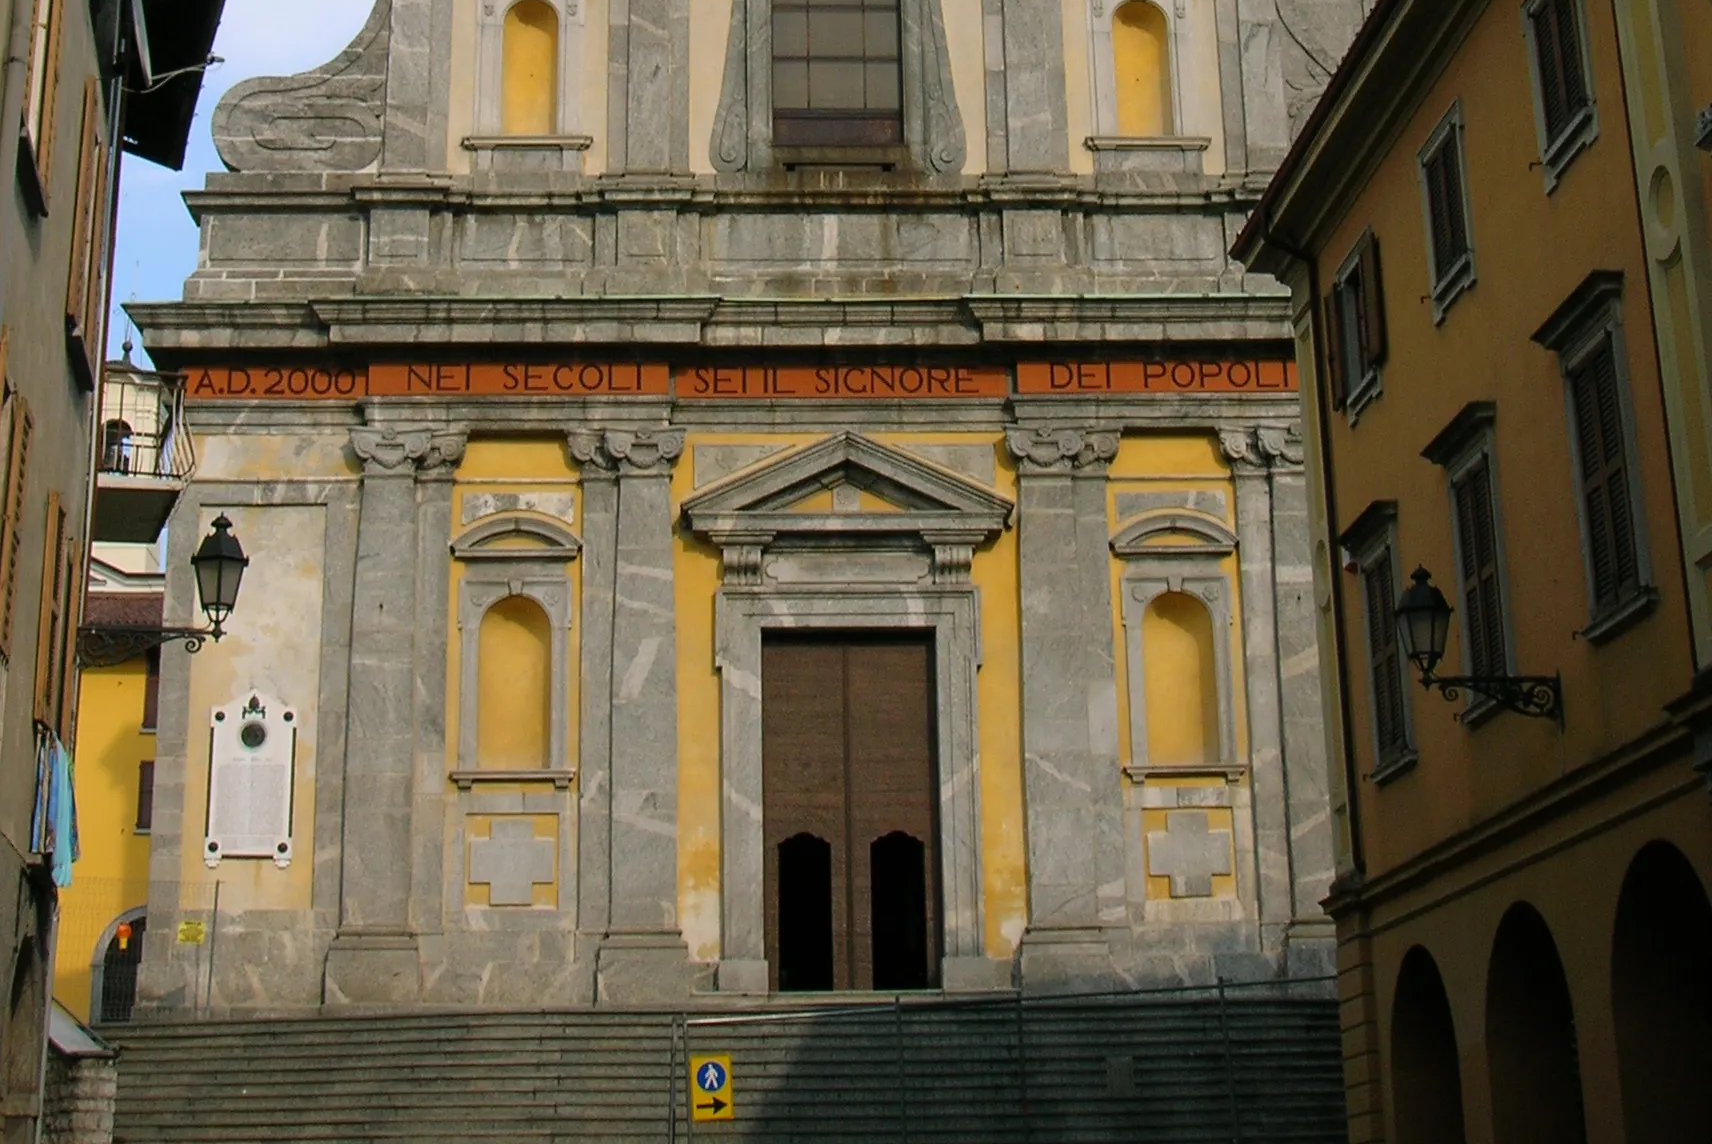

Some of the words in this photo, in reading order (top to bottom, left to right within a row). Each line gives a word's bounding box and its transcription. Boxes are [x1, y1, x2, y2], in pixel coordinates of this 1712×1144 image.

[194, 368, 256, 395] A.D.
[263, 368, 356, 395] 2000
[407, 364, 471, 391] NEI
[502, 364, 642, 391] SECOLI
[694, 367, 748, 394] SEI
[763, 367, 796, 394] IL
[814, 367, 980, 394] SIGNORE
[1050, 362, 1111, 389] DEI
[1143, 361, 1289, 389] POPOLI
